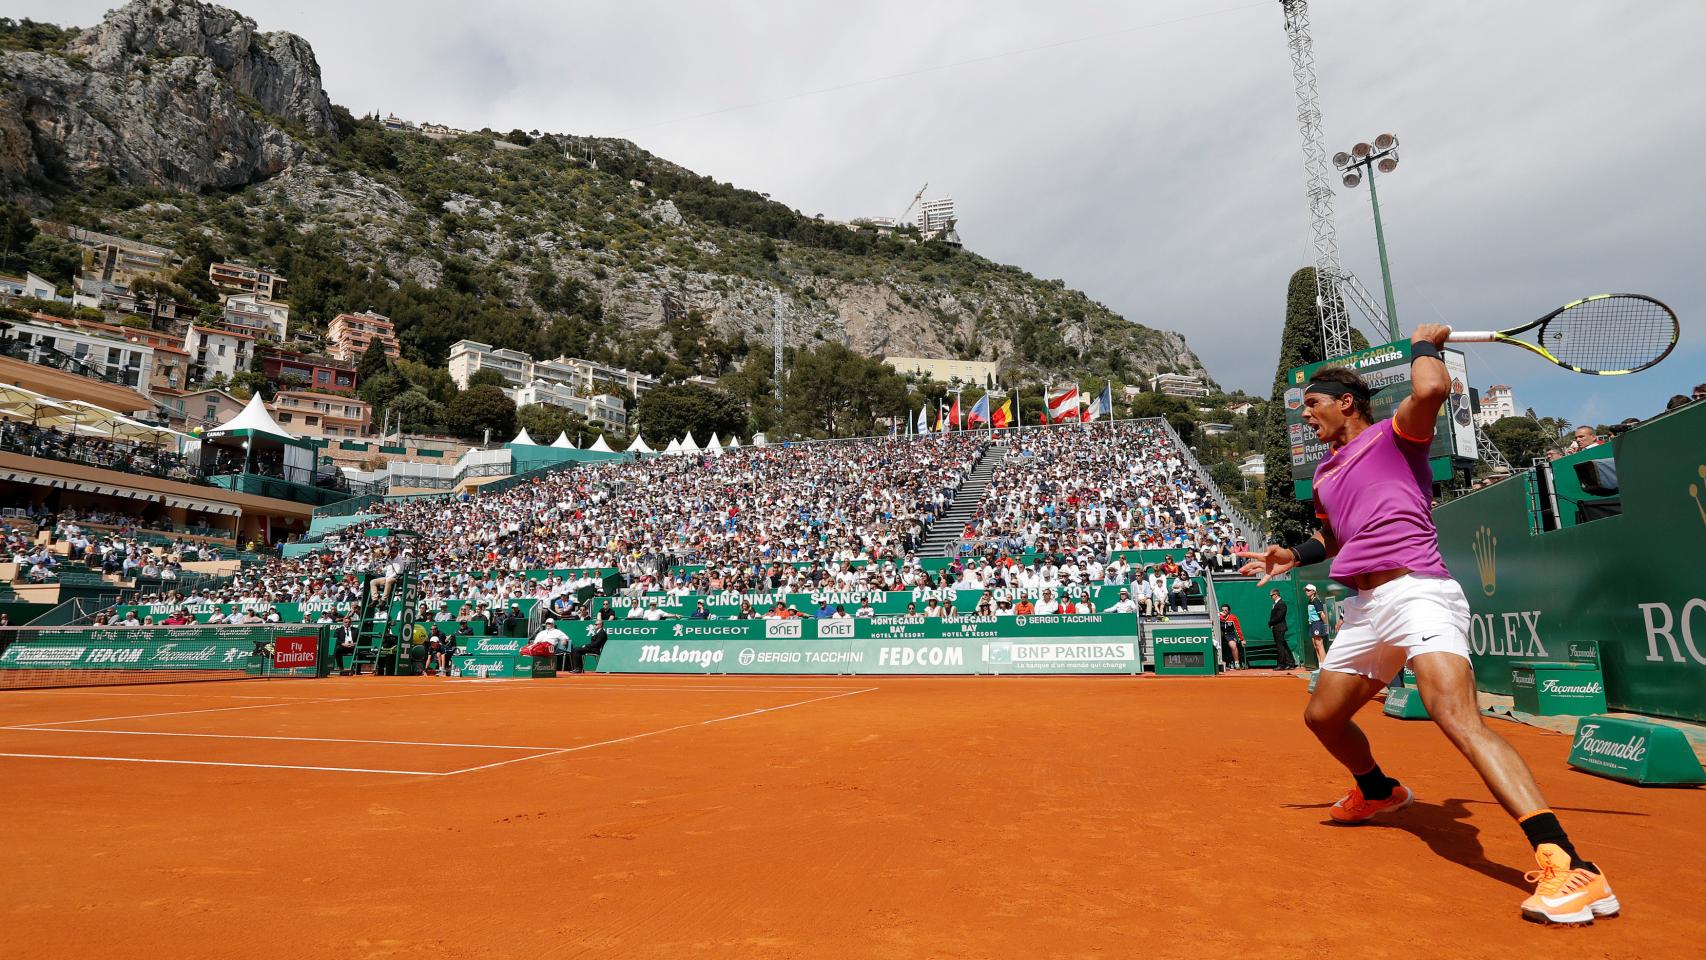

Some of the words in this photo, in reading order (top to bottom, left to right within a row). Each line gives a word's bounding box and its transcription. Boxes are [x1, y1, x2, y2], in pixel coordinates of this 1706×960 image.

[1360, 351, 1403, 368] MASTERS
[1367, 373, 1405, 389] MASTERS
[1305, 442, 1330, 454] Rafael
[1306, 451, 1325, 461] NAD
[706, 593, 786, 606] CINCINNATI
[810, 591, 887, 605] SHANGHAI
[912, 589, 957, 602] PARIS
[993, 587, 1058, 600] ONDRS
[1063, 585, 1102, 599] 2017
[298, 601, 335, 612] MONTE
[400, 583, 416, 659] RICOH
[870, 617, 925, 625] MONTE-CARLO
[941, 616, 998, 624] MONTE-CARLO
[1028, 616, 1060, 624] SERGIO
[1062, 615, 1102, 623] TACCHINI
[604, 627, 658, 635] EUGEOT
[685, 627, 750, 635] PEUGEOT
[890, 625, 905, 633] BAY
[961, 624, 977, 632] BAY
[1470, 610, 1549, 657] OLEX
[474, 638, 519, 652] Façonnable
[1155, 636, 1209, 644] PEUGEOT
[291, 642, 303, 652] Fly
[1017, 646, 1050, 659] BNP
[1055, 645, 1125, 659] PARIBAS
[1569, 644, 1597, 658] Façonnable
[85, 648, 144, 663] FEDCOM
[276, 650, 314, 663] Emirates
[638, 645, 724, 668] Malongo
[757, 652, 801, 663] SERGIO
[804, 651, 864, 663] TACCHINI
[878, 647, 963, 666] FEDCOM
[1540, 679, 1603, 694] Façonnable
[1573, 724, 1646, 762] Façonnable
